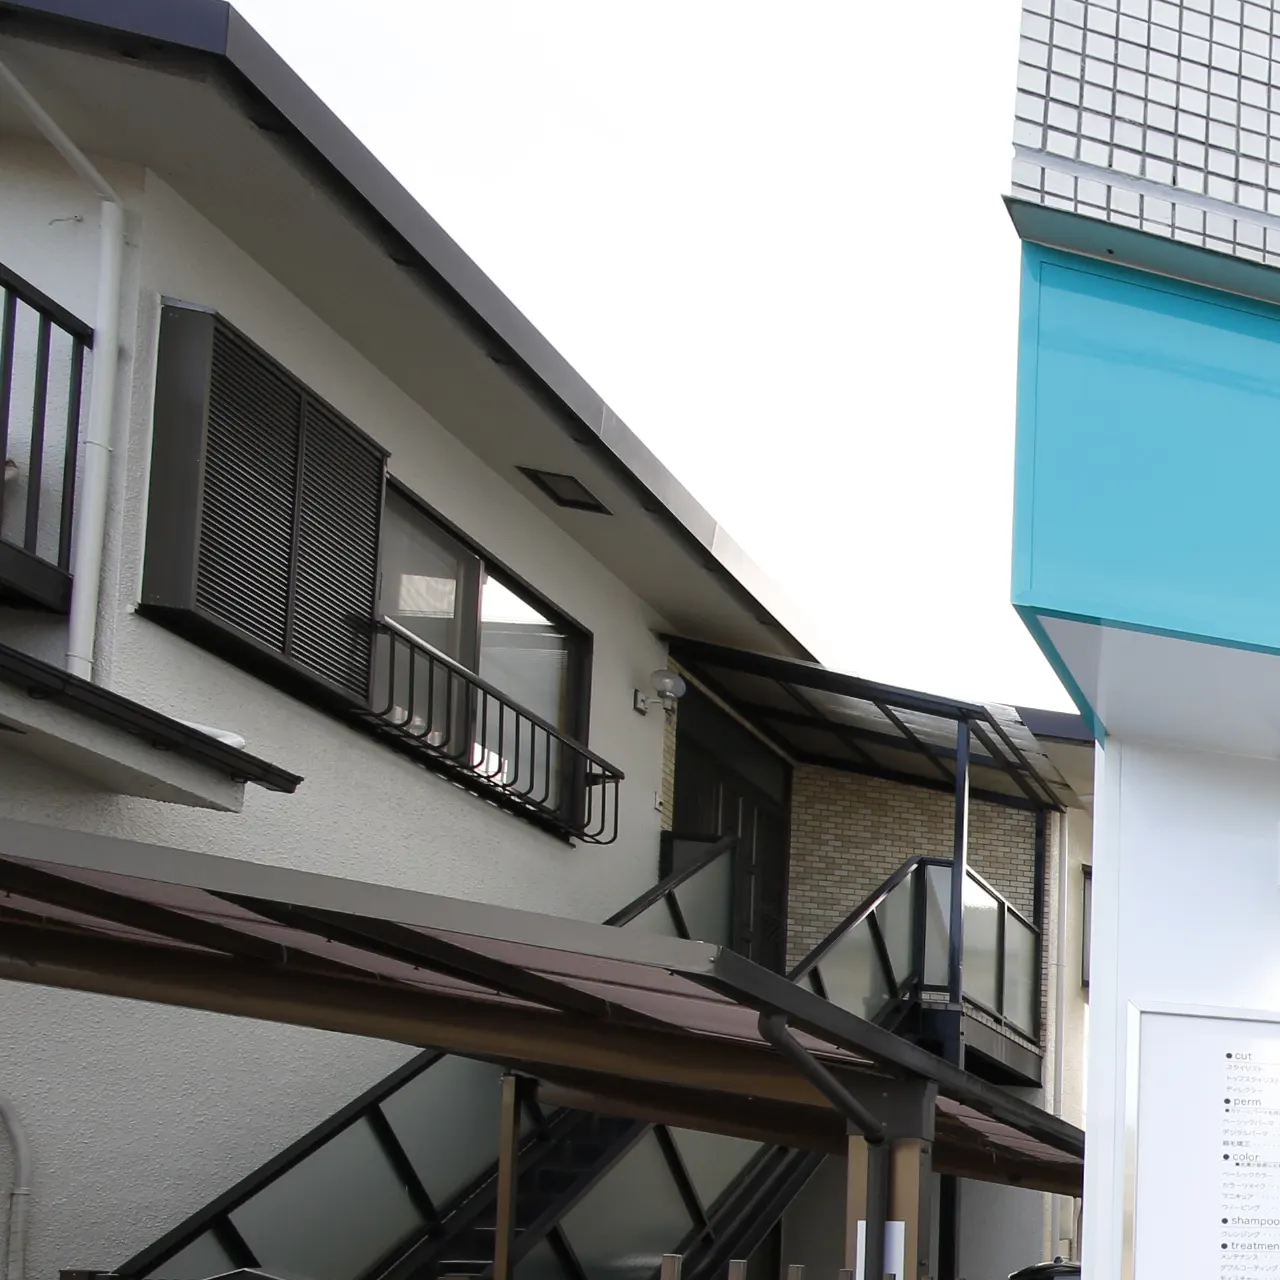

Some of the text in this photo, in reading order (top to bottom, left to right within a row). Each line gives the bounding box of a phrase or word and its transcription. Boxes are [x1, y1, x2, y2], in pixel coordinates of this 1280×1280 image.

[1235, 1052, 1252, 1060] cut
[1234, 1098, 1261, 1107] perm
[1233, 1152, 1259, 1162] color
[1231, 1217, 1280, 1226] shampoo
